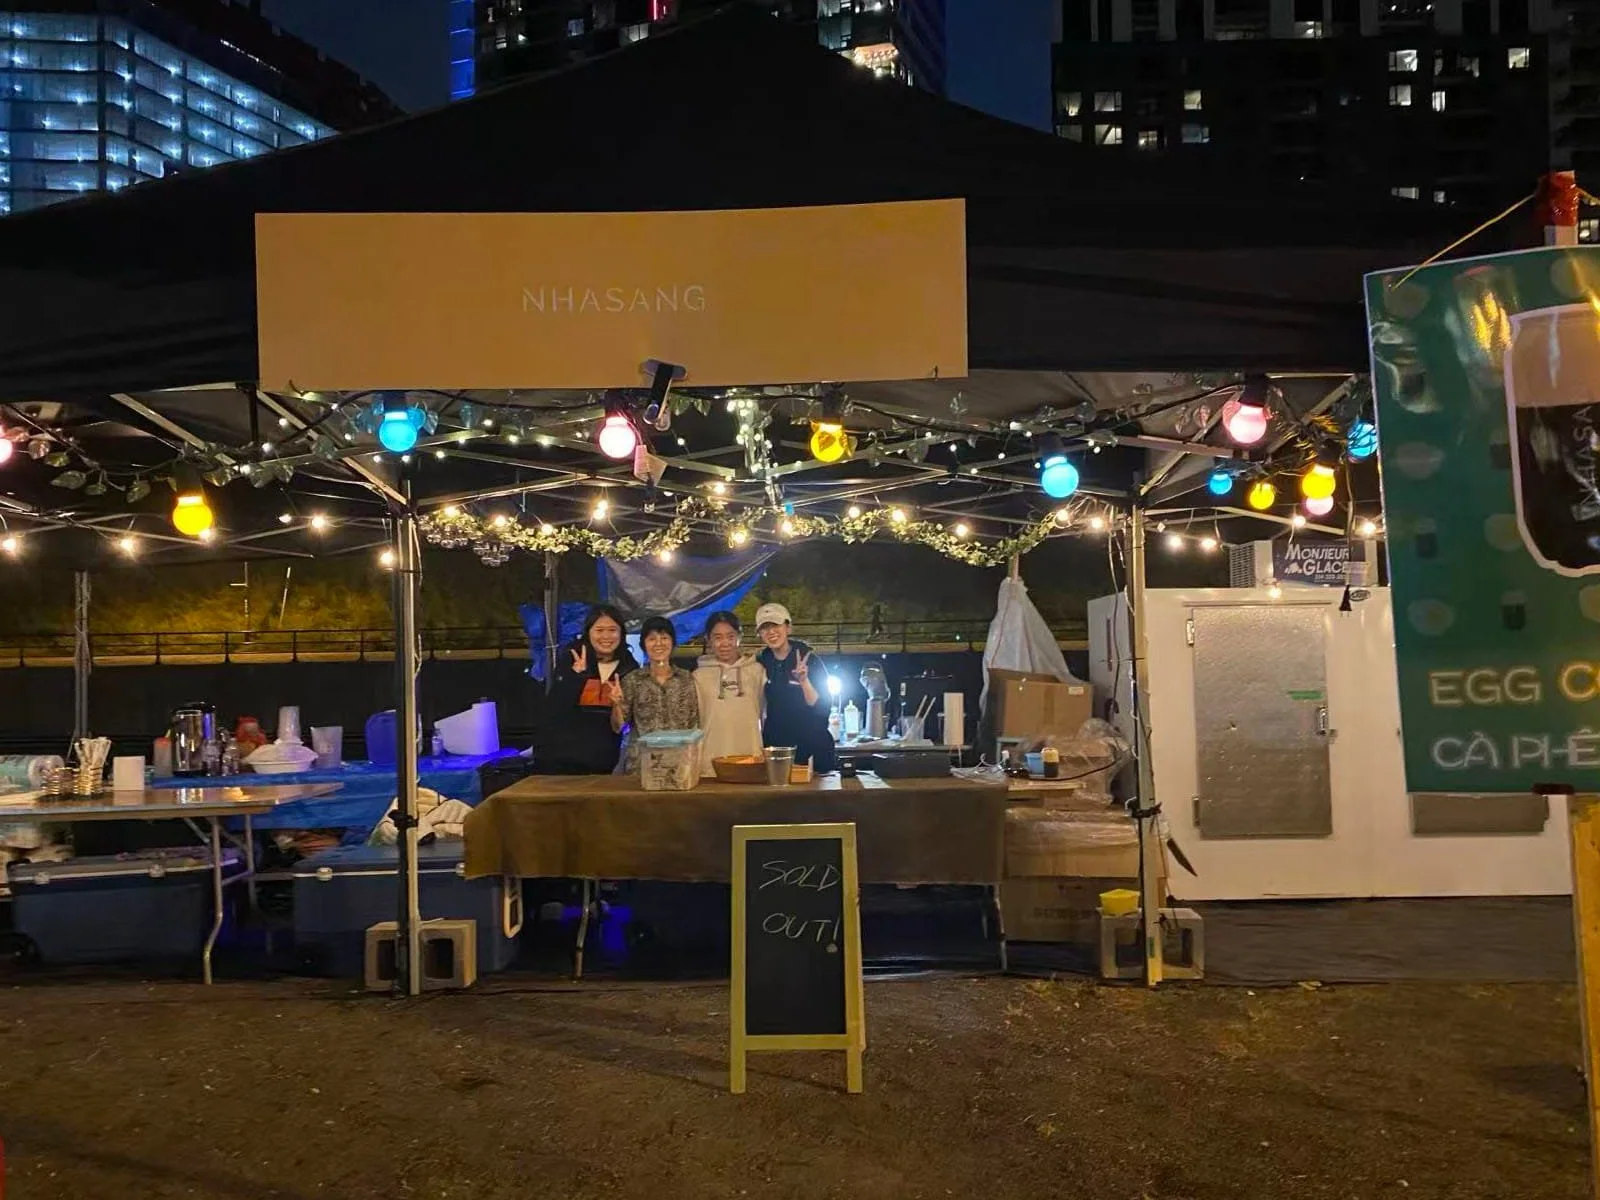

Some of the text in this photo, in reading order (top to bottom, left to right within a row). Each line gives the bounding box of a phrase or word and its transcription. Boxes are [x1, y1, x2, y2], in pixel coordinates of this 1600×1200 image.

[521, 285, 706, 313] NHASANG
[1284, 543, 1350, 561] MONSIEUR
[1430, 661, 1600, 705] EGG C
[759, 859, 840, 892] SOLD
[762, 912, 840, 953] OUT!
